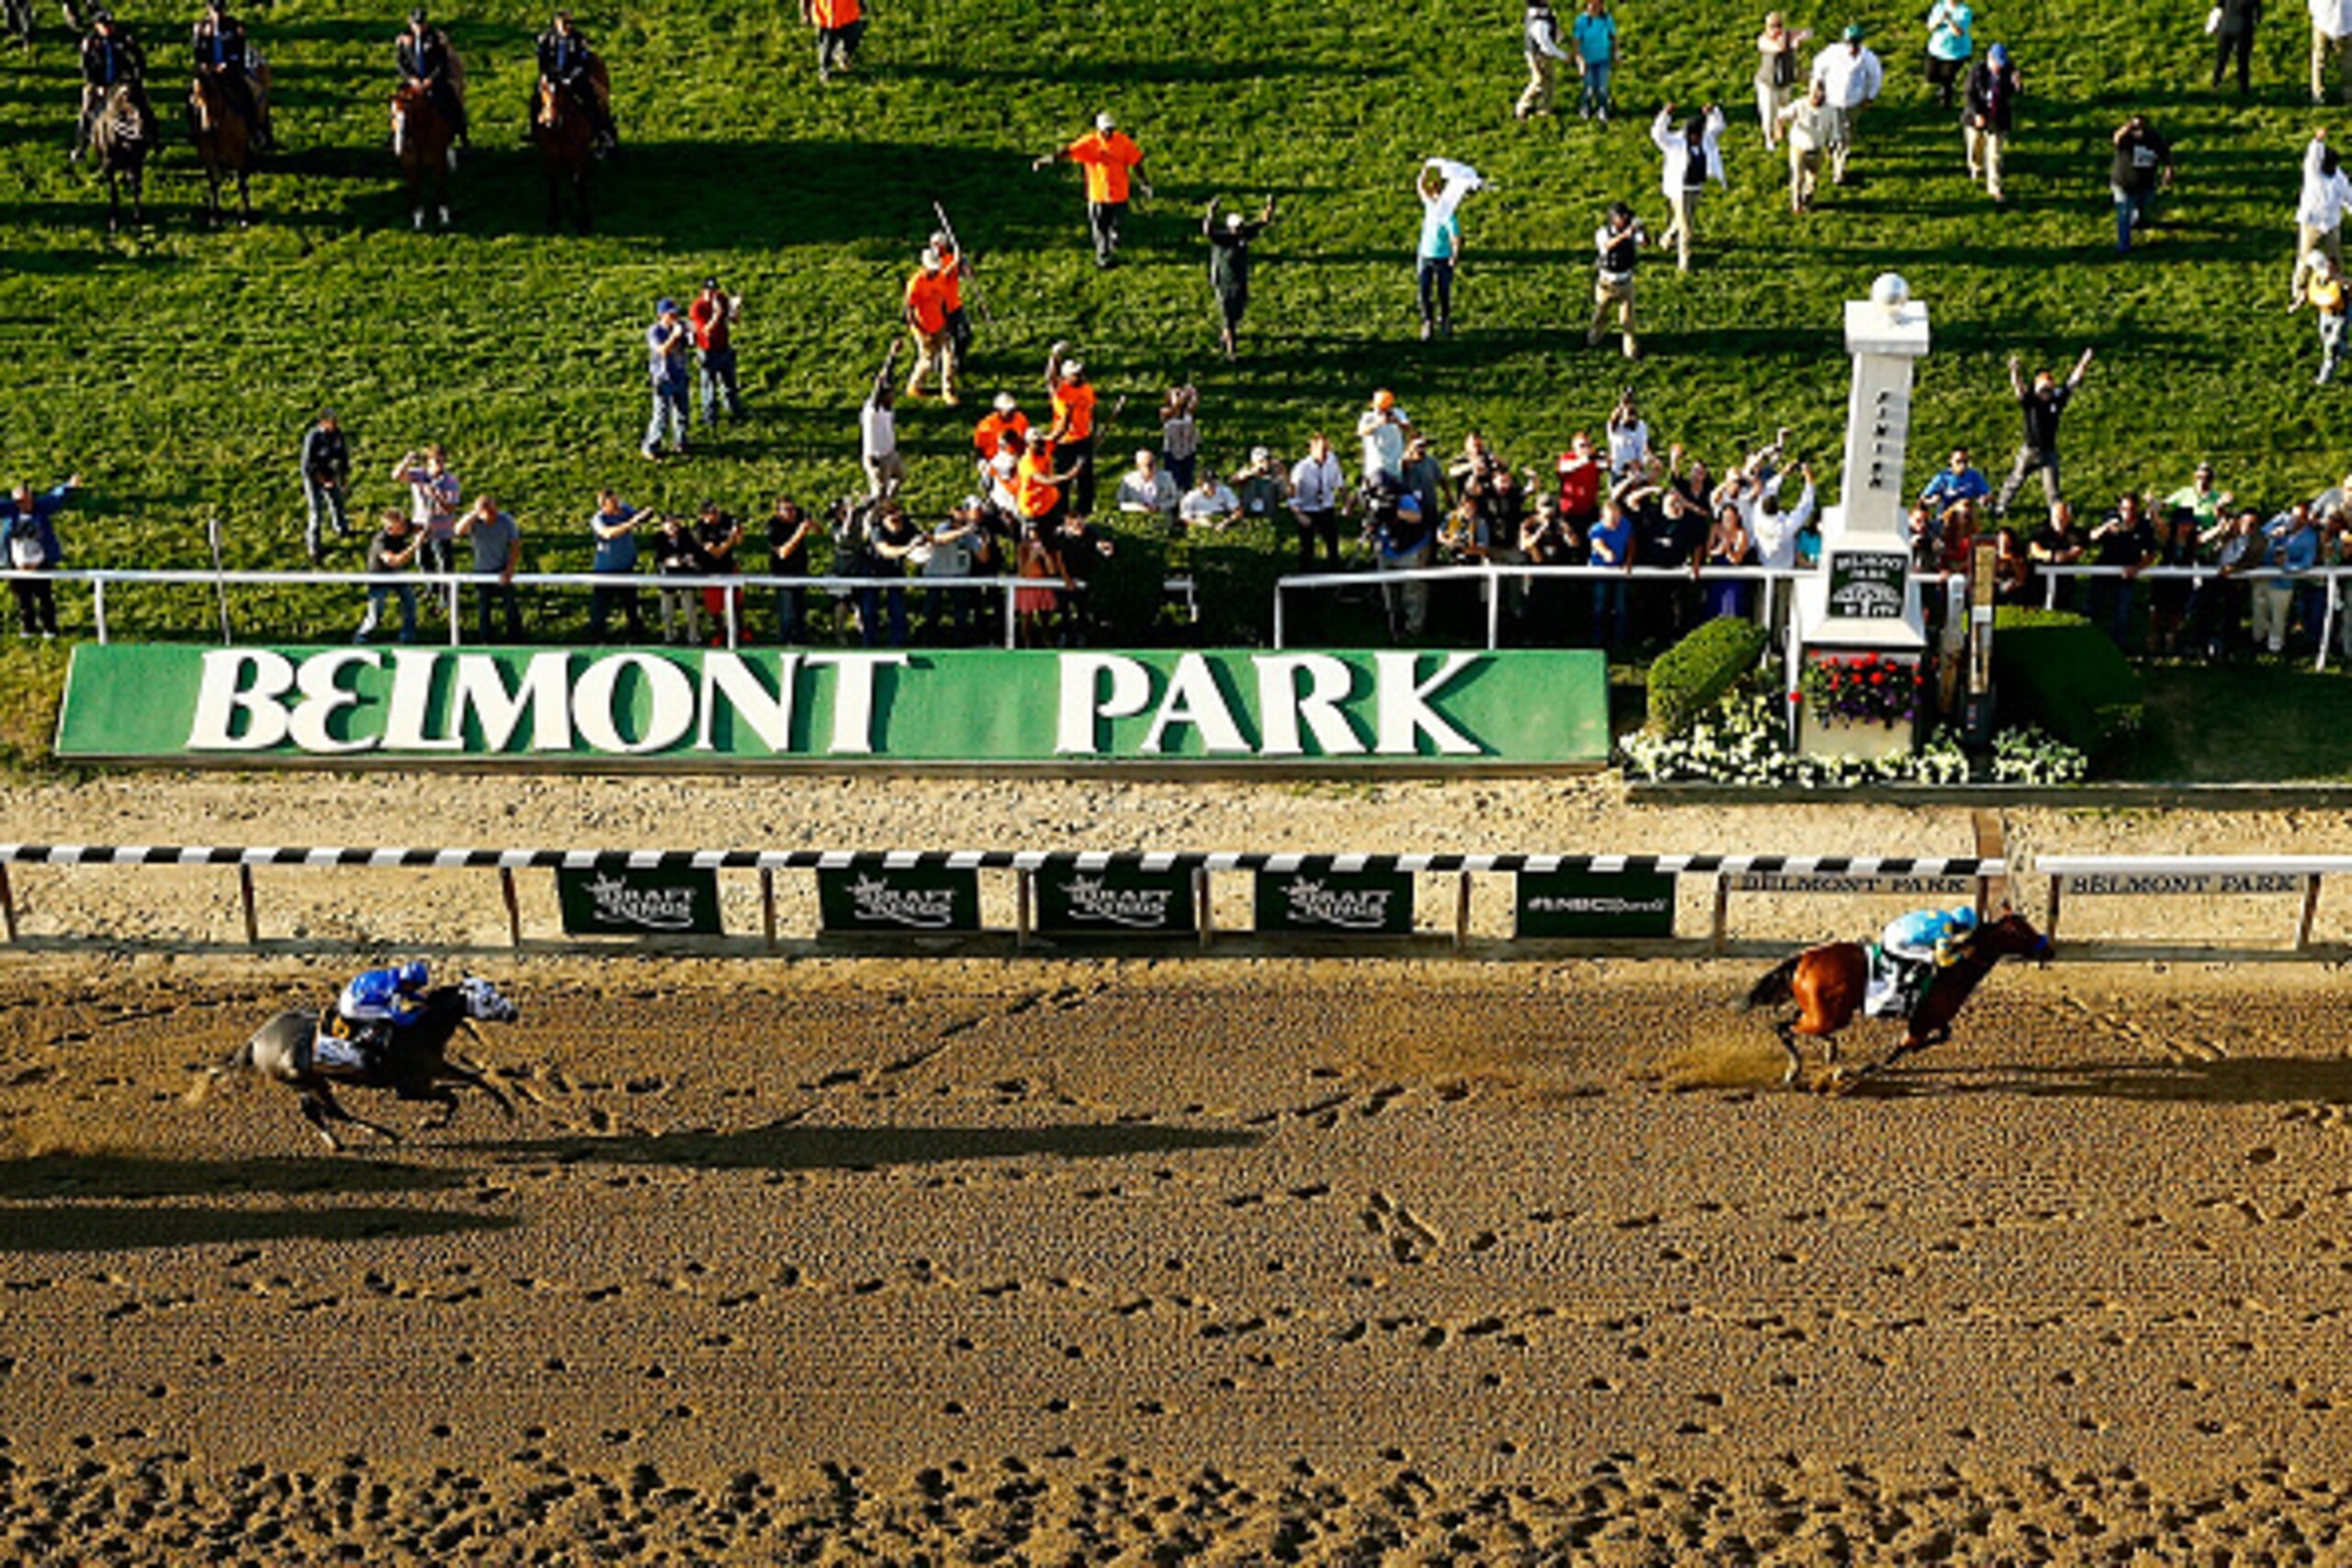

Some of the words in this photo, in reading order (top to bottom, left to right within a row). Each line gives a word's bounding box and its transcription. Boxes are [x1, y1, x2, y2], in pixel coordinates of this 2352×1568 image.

[1868, 389, 1891, 489] FINISH
[187, 649, 909, 753] BELMONT
[1055, 651, 1483, 756] PARK
[1742, 875, 1881, 892] BELMONT
[1891, 876, 1966, 892] PARK
[2071, 874, 2210, 894] BELMONT
[2220, 873, 2298, 892] PARK
